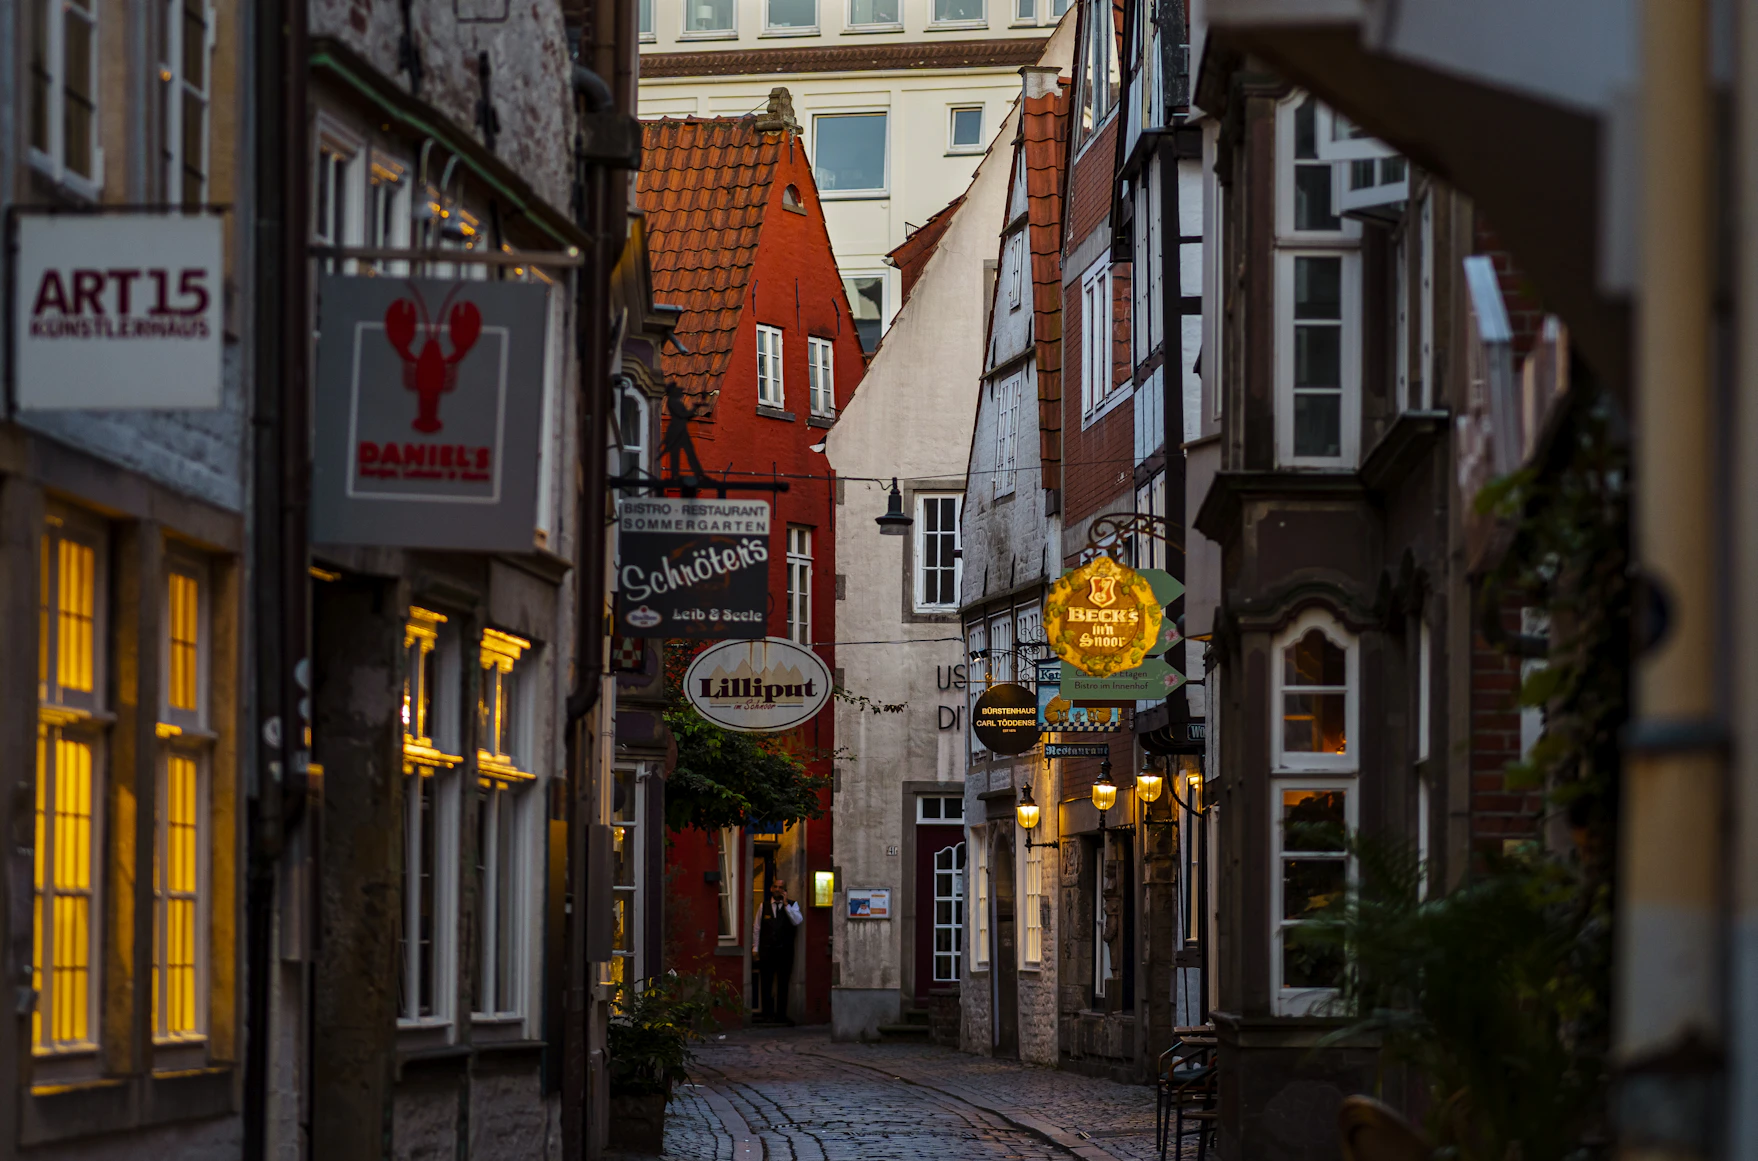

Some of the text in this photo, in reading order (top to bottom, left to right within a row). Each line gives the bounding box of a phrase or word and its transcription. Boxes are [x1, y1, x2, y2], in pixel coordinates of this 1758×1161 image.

[624, 503, 672, 515] BISTRO
[682, 505, 766, 517] RESTAURANT
[624, 519, 766, 532] SOMMERGARTEN
[622, 537, 768, 601] Schröter's
[672, 608, 705, 621] Leib
[709, 608, 720, 622] &
[723, 609, 763, 623] Seele
[1040, 669, 1061, 681] Kat
[1120, 669, 1148, 680] Etagen
[699, 677, 818, 703] Lilliput
[1074, 681, 1149, 690] Bistro im Innenhof
[733, 701, 743, 710] im
[982, 706, 1037, 715] BÜRSTENHAUS
[976, 719, 996, 727] CARL
[1045, 745, 1109, 756] Restaurant
